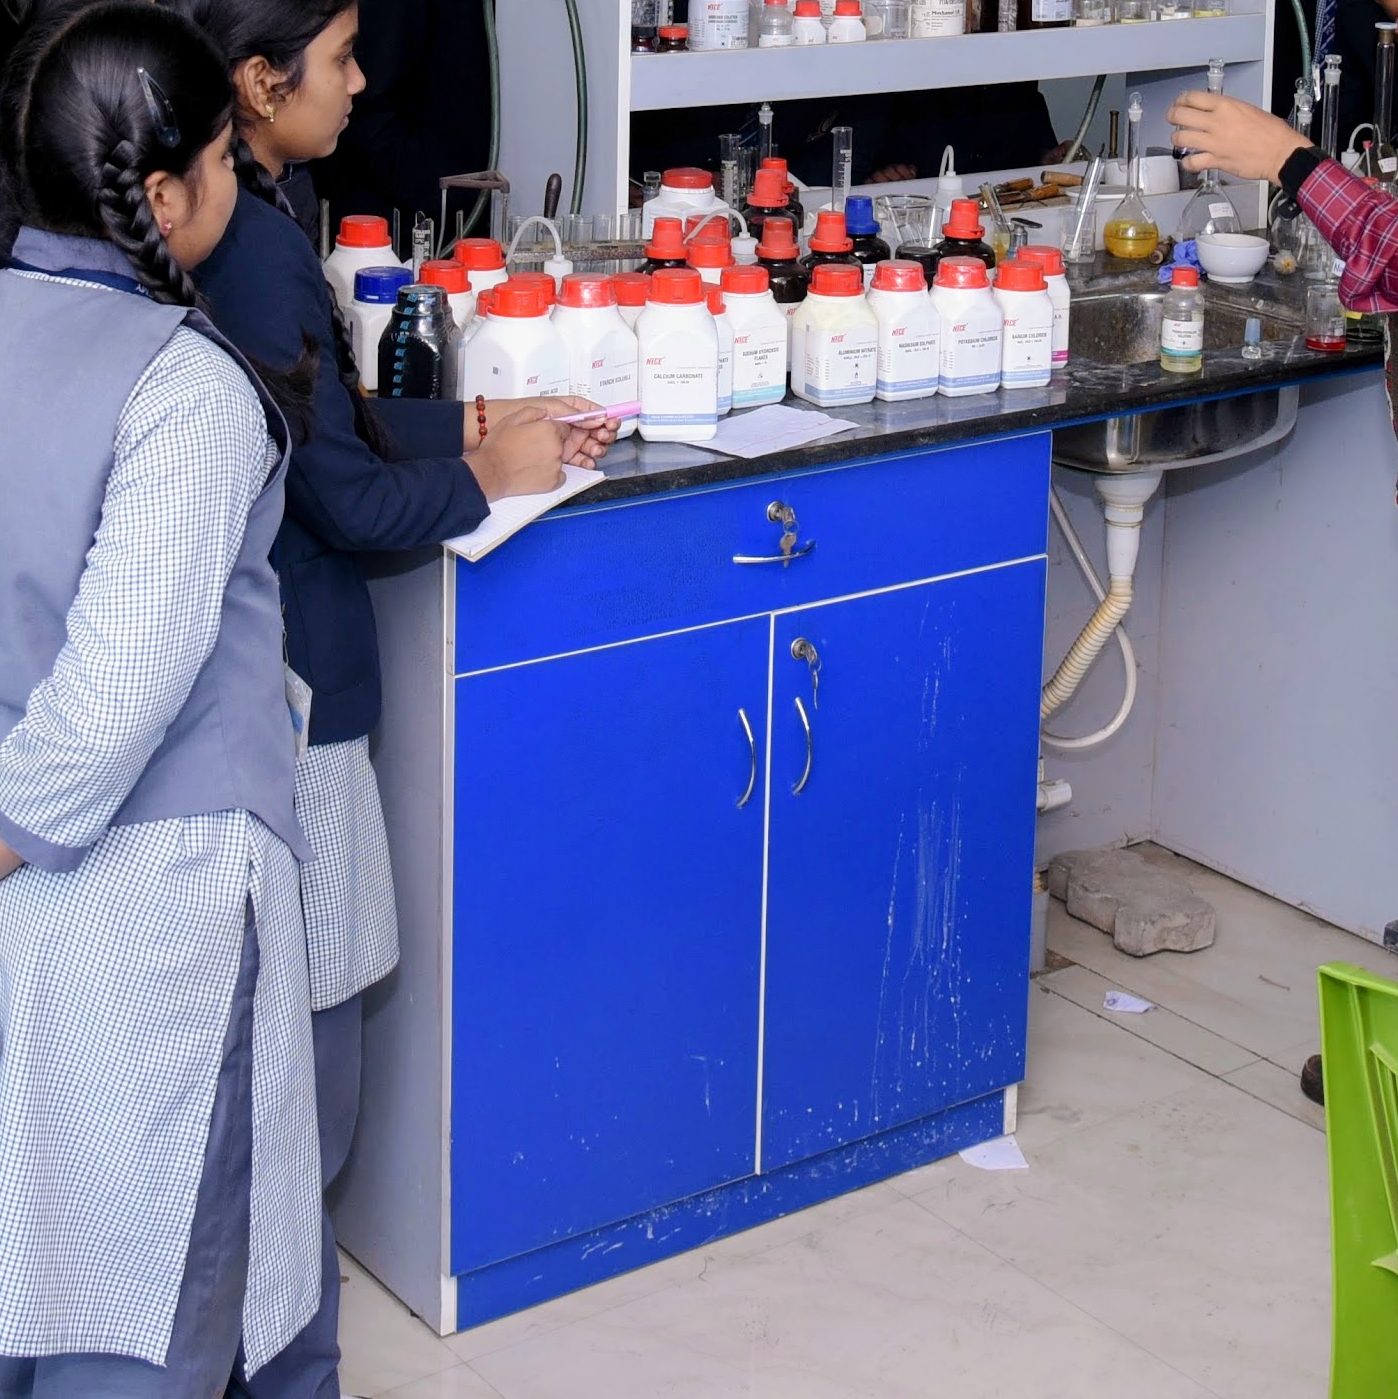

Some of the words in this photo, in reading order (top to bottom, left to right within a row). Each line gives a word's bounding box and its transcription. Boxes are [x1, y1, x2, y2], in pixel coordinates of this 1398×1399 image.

[1004, 319, 1017, 327] NICE
[892, 327, 905, 336] NICE
[953, 324, 966, 332] NICE
[734, 336, 748, 344] NICE
[831, 334, 844, 343] NICE
[980, 335, 998, 343] CHLORIDE
[759, 347, 780, 355] HYDROXIDE
[591, 358, 605, 369] NICE
[646, 357, 663, 366] NICE
